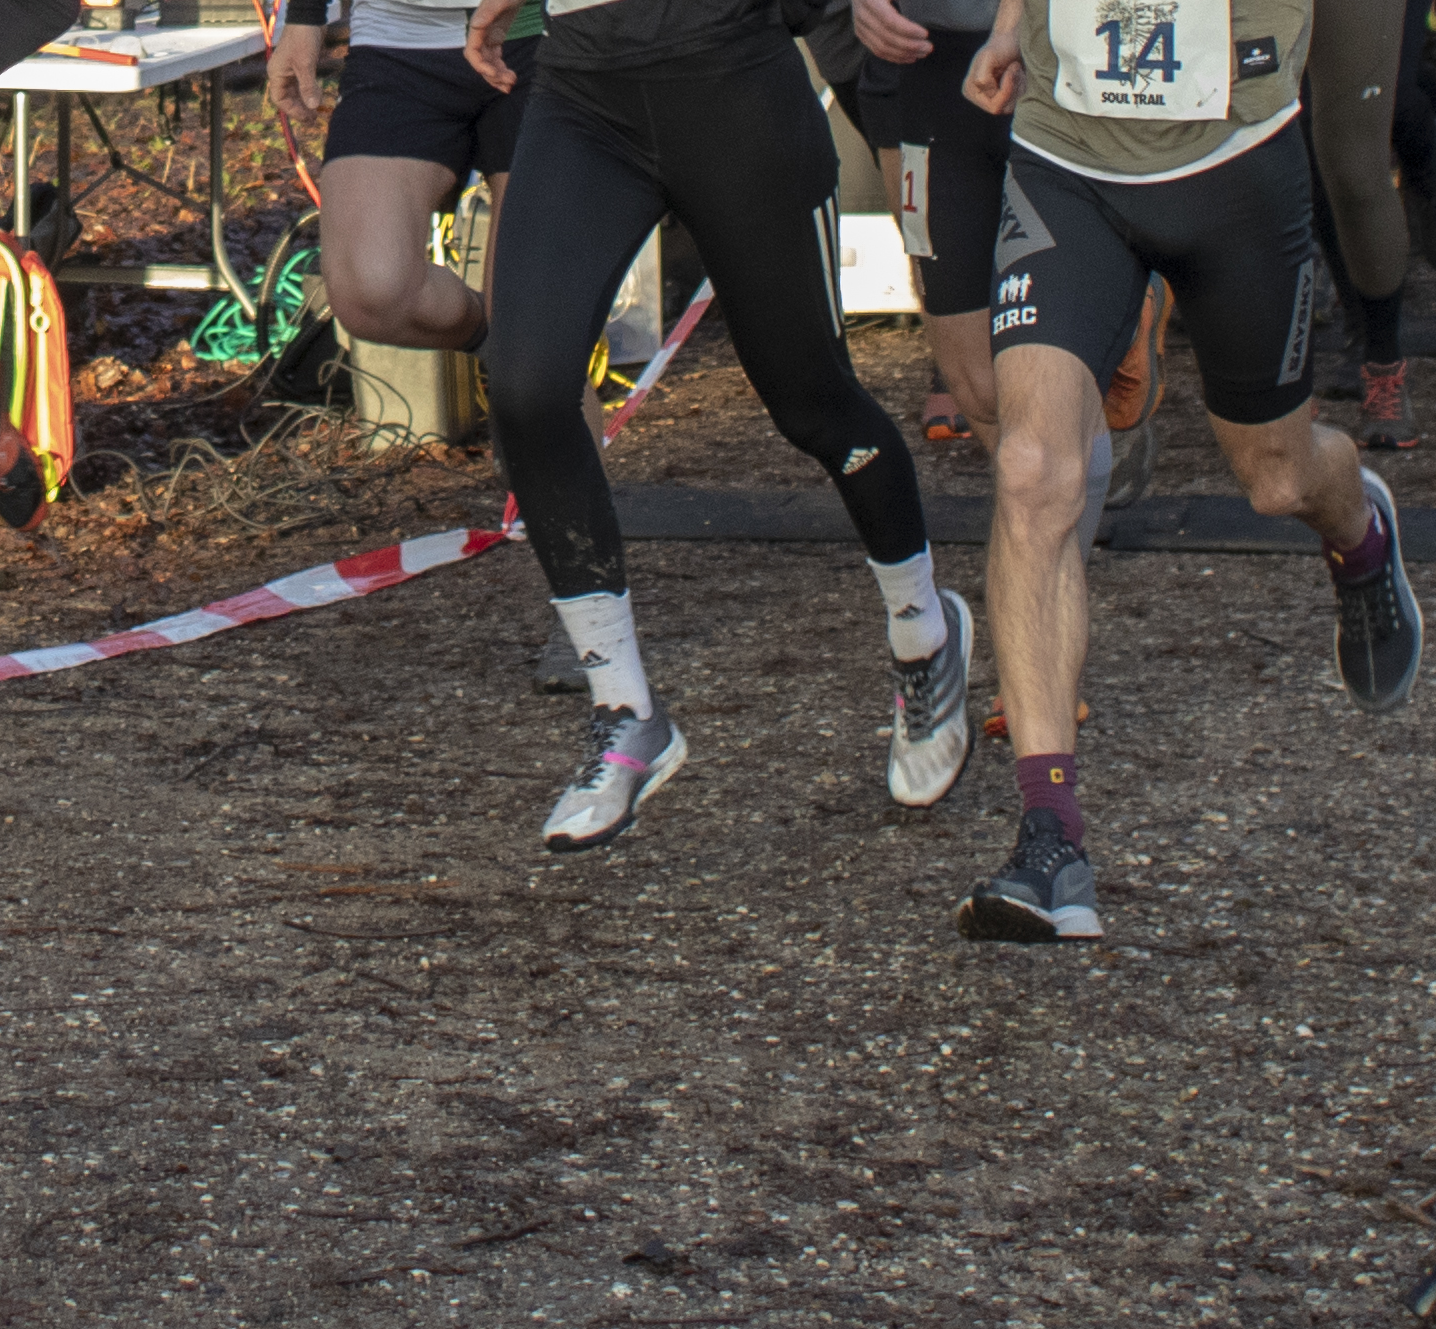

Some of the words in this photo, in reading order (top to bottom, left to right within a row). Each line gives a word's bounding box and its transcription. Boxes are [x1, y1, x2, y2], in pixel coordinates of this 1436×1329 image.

[1095, 19, 1183, 83] 14
[1101, 91, 1130, 105] SOUL
[1133, 93, 1167, 106] TRAIL
[992, 304, 1038, 336] HRC
